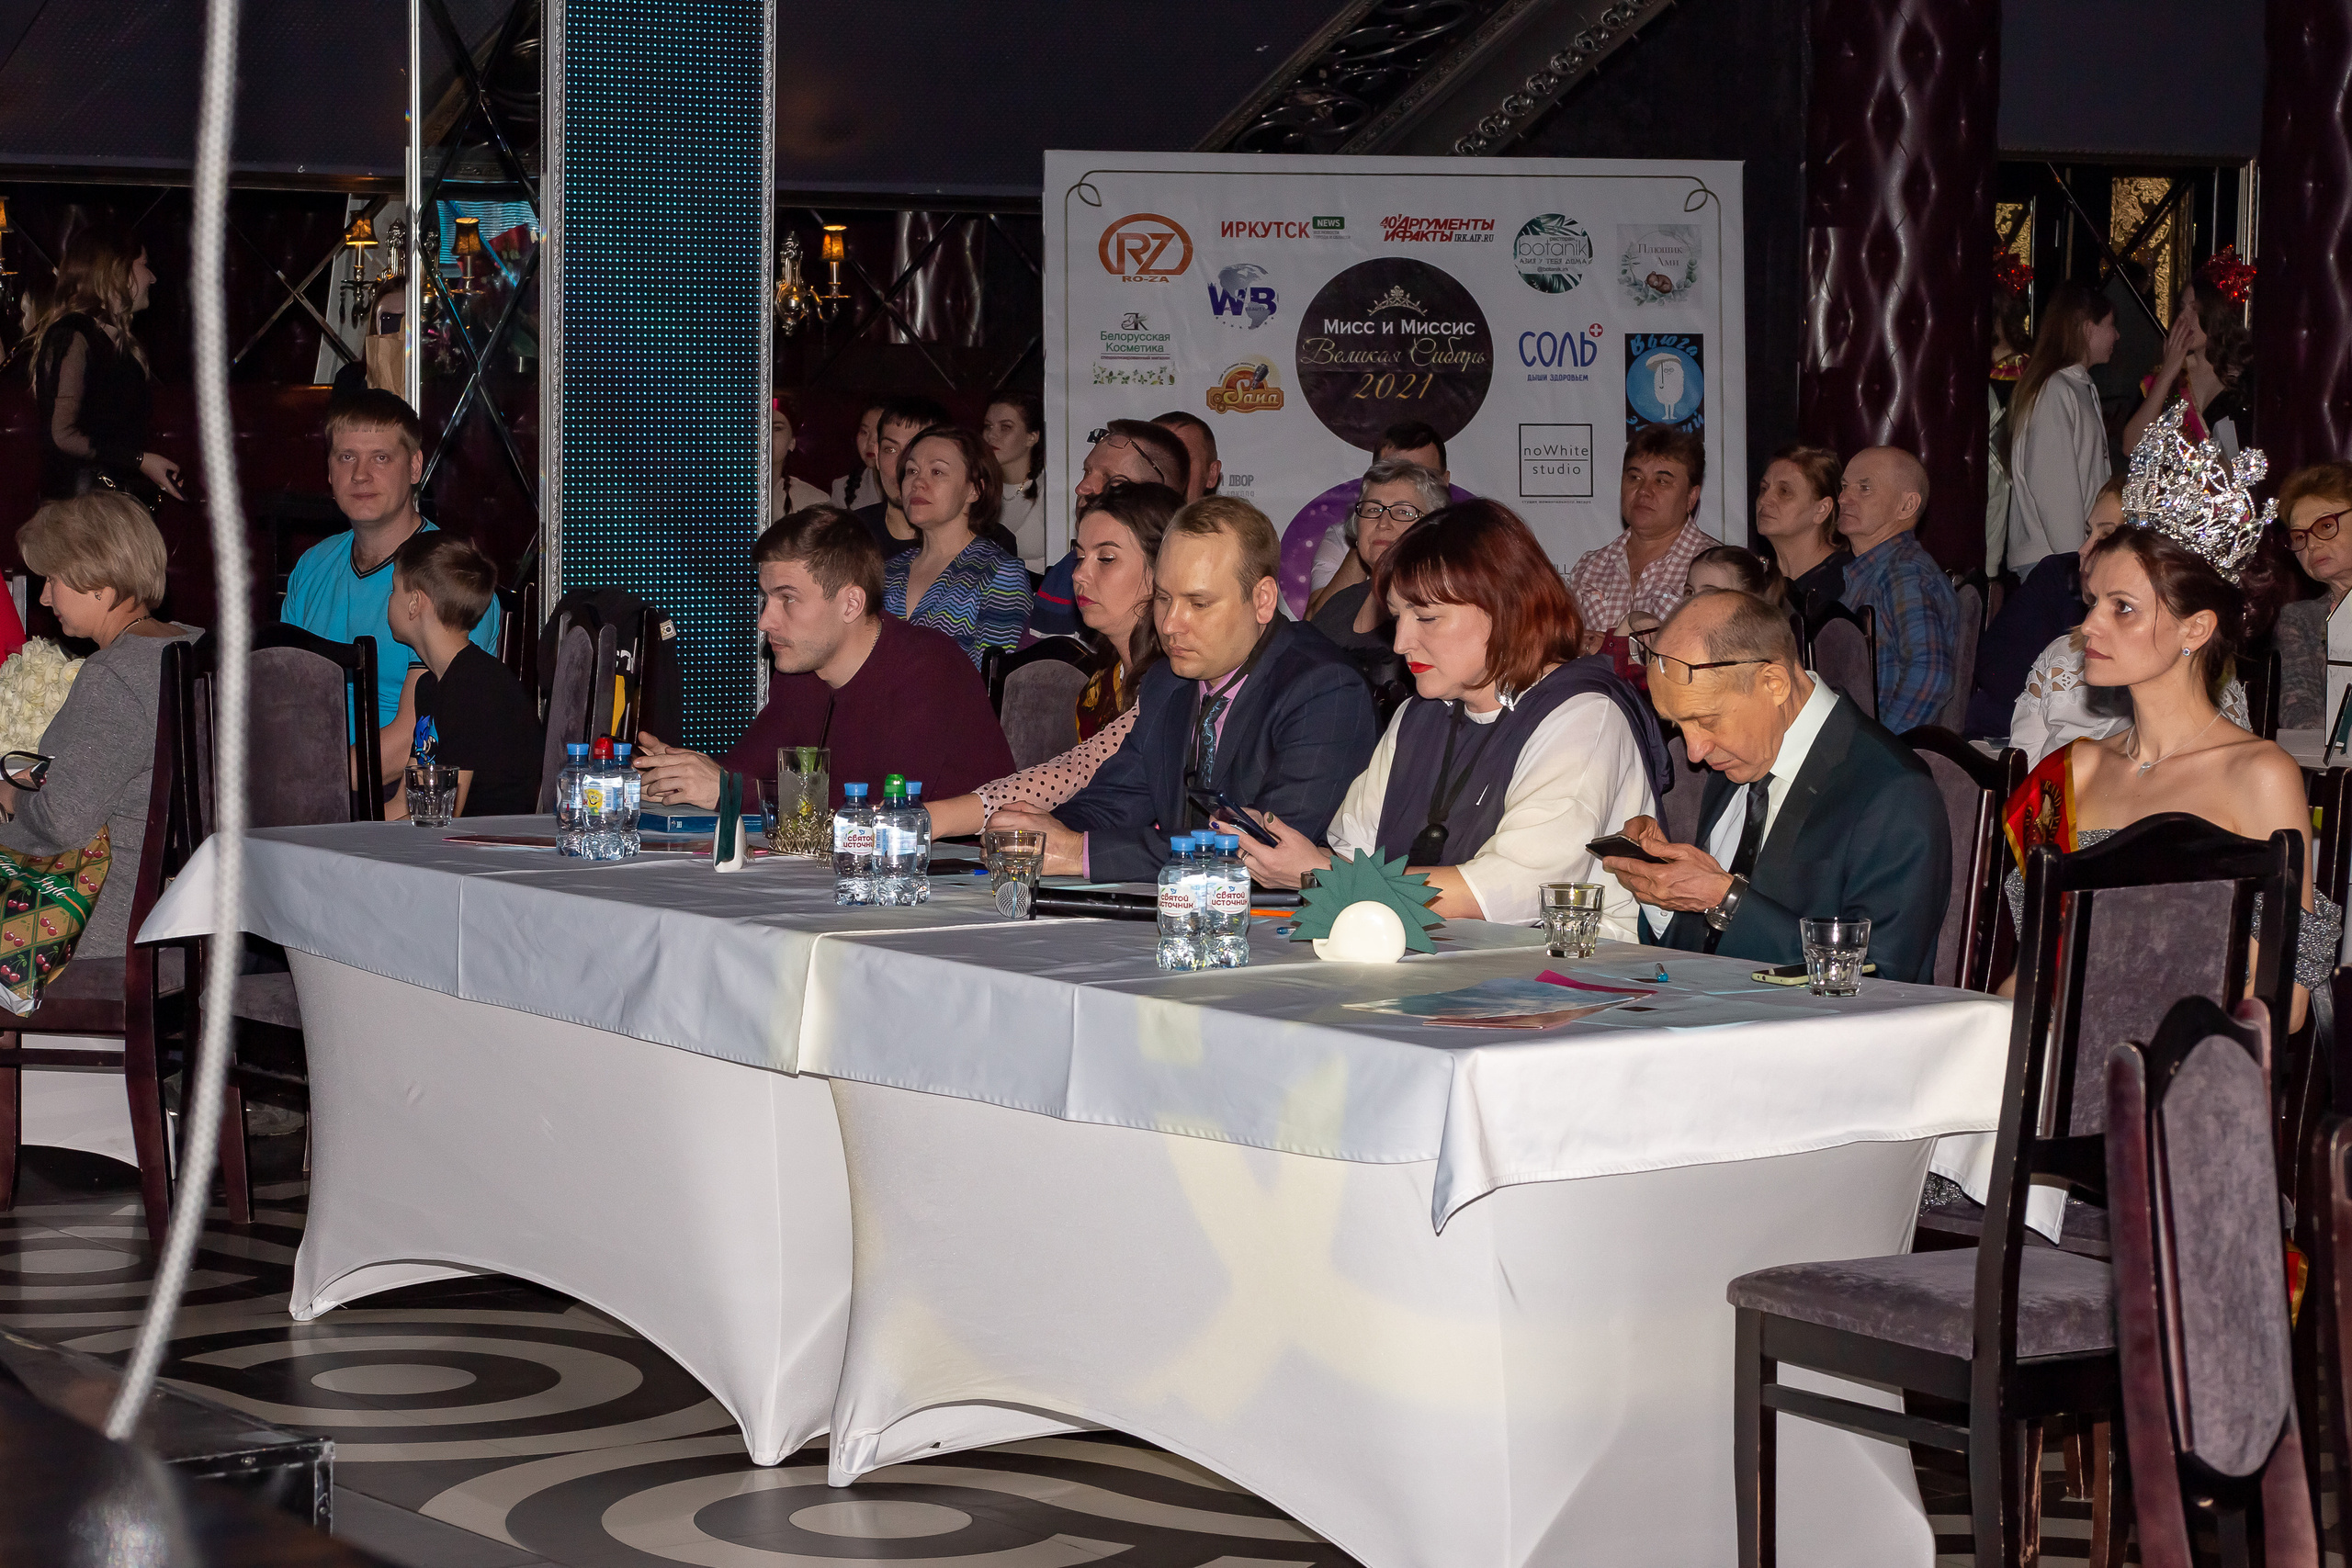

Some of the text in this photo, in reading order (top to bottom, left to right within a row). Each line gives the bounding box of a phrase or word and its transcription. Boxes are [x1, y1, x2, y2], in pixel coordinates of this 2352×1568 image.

[1317, 219, 1340, 227] NEWS
[1396, 216, 1495, 231] АРГУМЕНТЫ
[1221, 220, 1310, 239] ИРКУТСК
[1519, 239, 1588, 256] botanik
[1638, 243, 1683, 254] Плюшик
[1100, 331, 1170, 343] Белорусская
[1105, 342, 1164, 353] Косметика
[1300, 336, 1487, 372] Великая Сибирь
[1354, 373, 1433, 399] 2021
[1524, 445, 1589, 457] noWhite
[1532, 463, 1581, 475] studio
[1228, 474, 1254, 486] ДВОР
